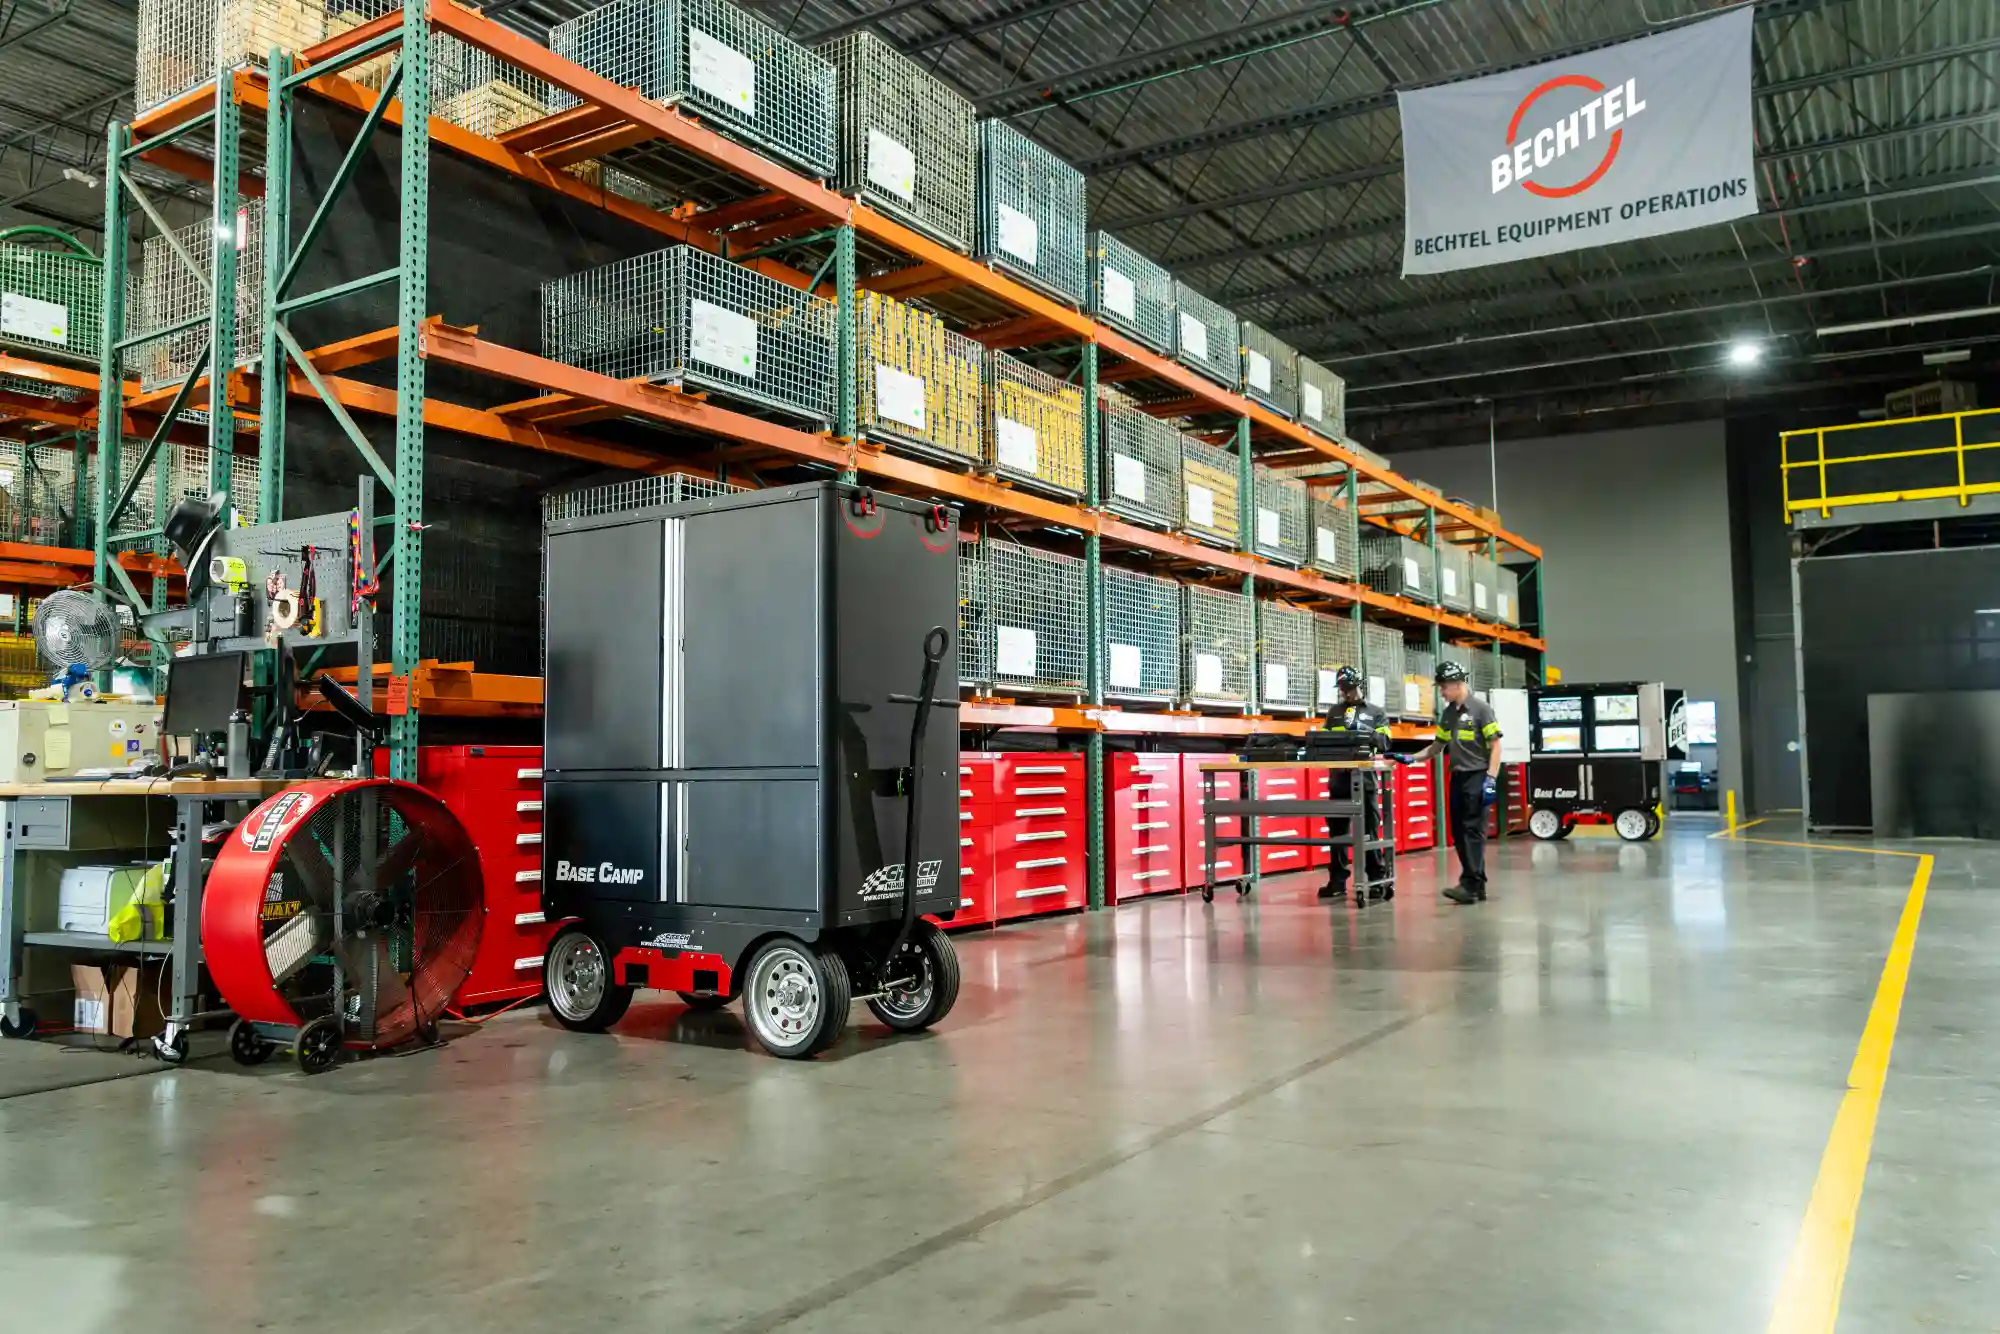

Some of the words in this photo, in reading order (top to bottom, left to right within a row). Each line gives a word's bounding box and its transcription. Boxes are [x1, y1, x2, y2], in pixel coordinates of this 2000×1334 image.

[1491, 77, 1646, 194] BECHTEL
[1414, 230, 1491, 256] BECHTEL
[1497, 207, 1613, 244] EQUIPMENT
[1620, 178, 1747, 220] OPERATIONS
[255, 793, 300, 849] BECHTEL
[556, 860, 596, 883] BASE
[599, 862, 644, 884] CAMP
